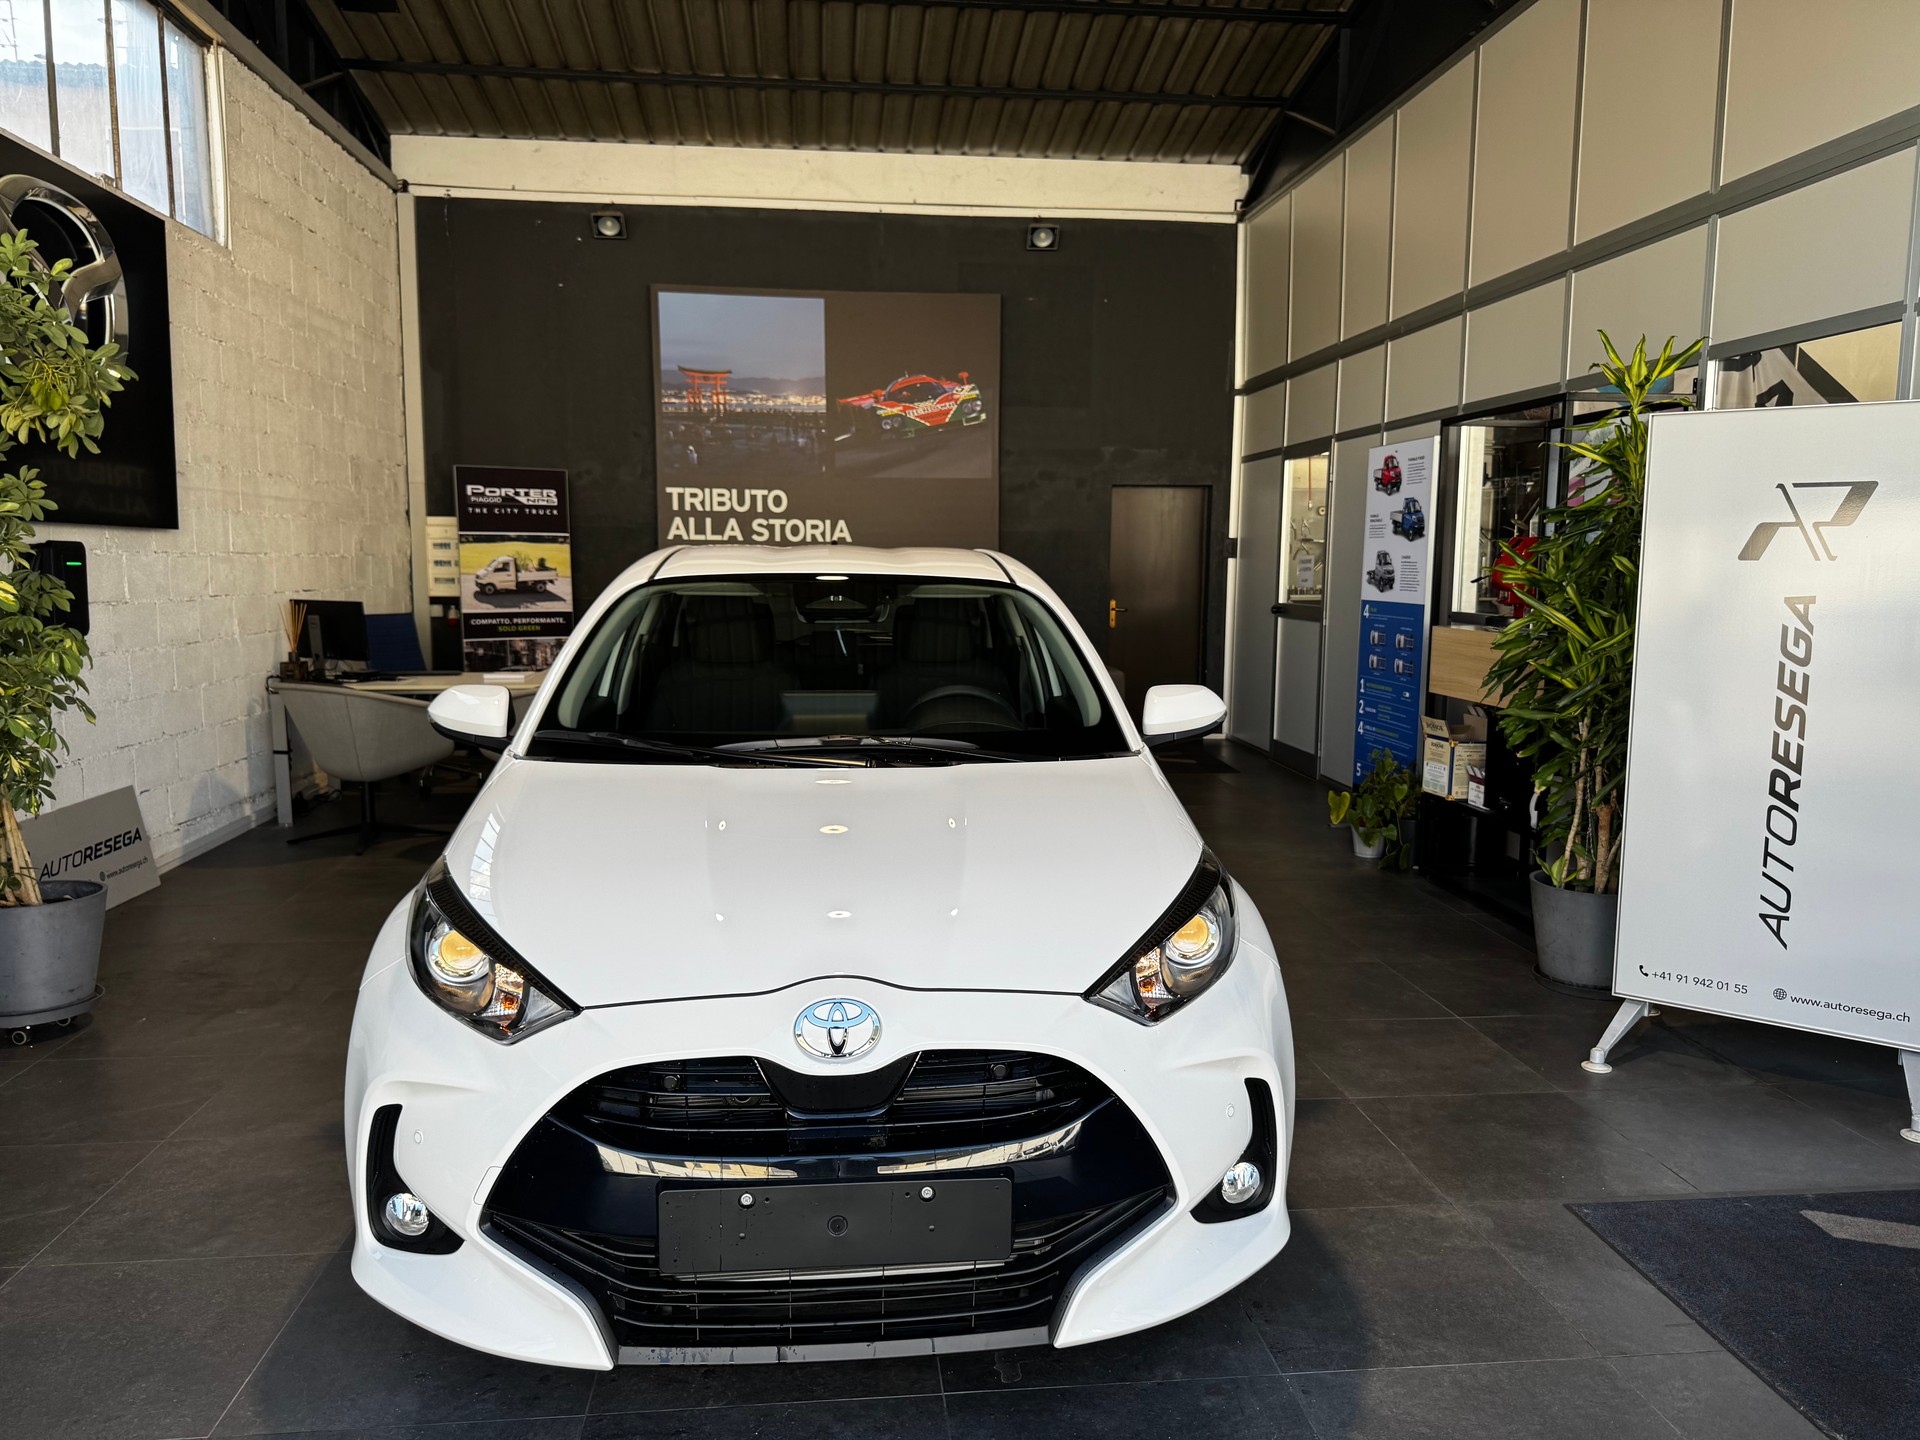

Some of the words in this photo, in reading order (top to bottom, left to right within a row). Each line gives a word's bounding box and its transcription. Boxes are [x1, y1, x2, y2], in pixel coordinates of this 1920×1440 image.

[466, 484, 557, 498] PORTER
[471, 496, 502, 504] PIAGGIO
[665, 486, 789, 514] TRIBUTO
[468, 507, 488, 515] THE
[494, 507, 520, 515] CITY
[524, 508, 558, 516] TRUCK
[667, 516, 744, 541] ALLA
[751, 518, 853, 543] STORIA
[471, 618, 512, 626] COMPATTO.
[513, 616, 566, 625] PERFORMANTE.
[1363, 604, 1369, 619] 4
[498, 625, 517, 633] SOLO
[1758, 595, 1817, 950] AUTORESEGA
[40, 827, 142, 881] AUTORESEGA
[106, 856, 149, 879] www.autoresega.ch
[1651, 971, 1672, 981] +41
[1675, 973, 1689, 985] 91
[1692, 976, 1714, 989] 942
[1716, 980, 1730, 991] 01
[1734, 983, 1748, 995] 55
[1790, 995, 1911, 1023] www.autoresega.ch
